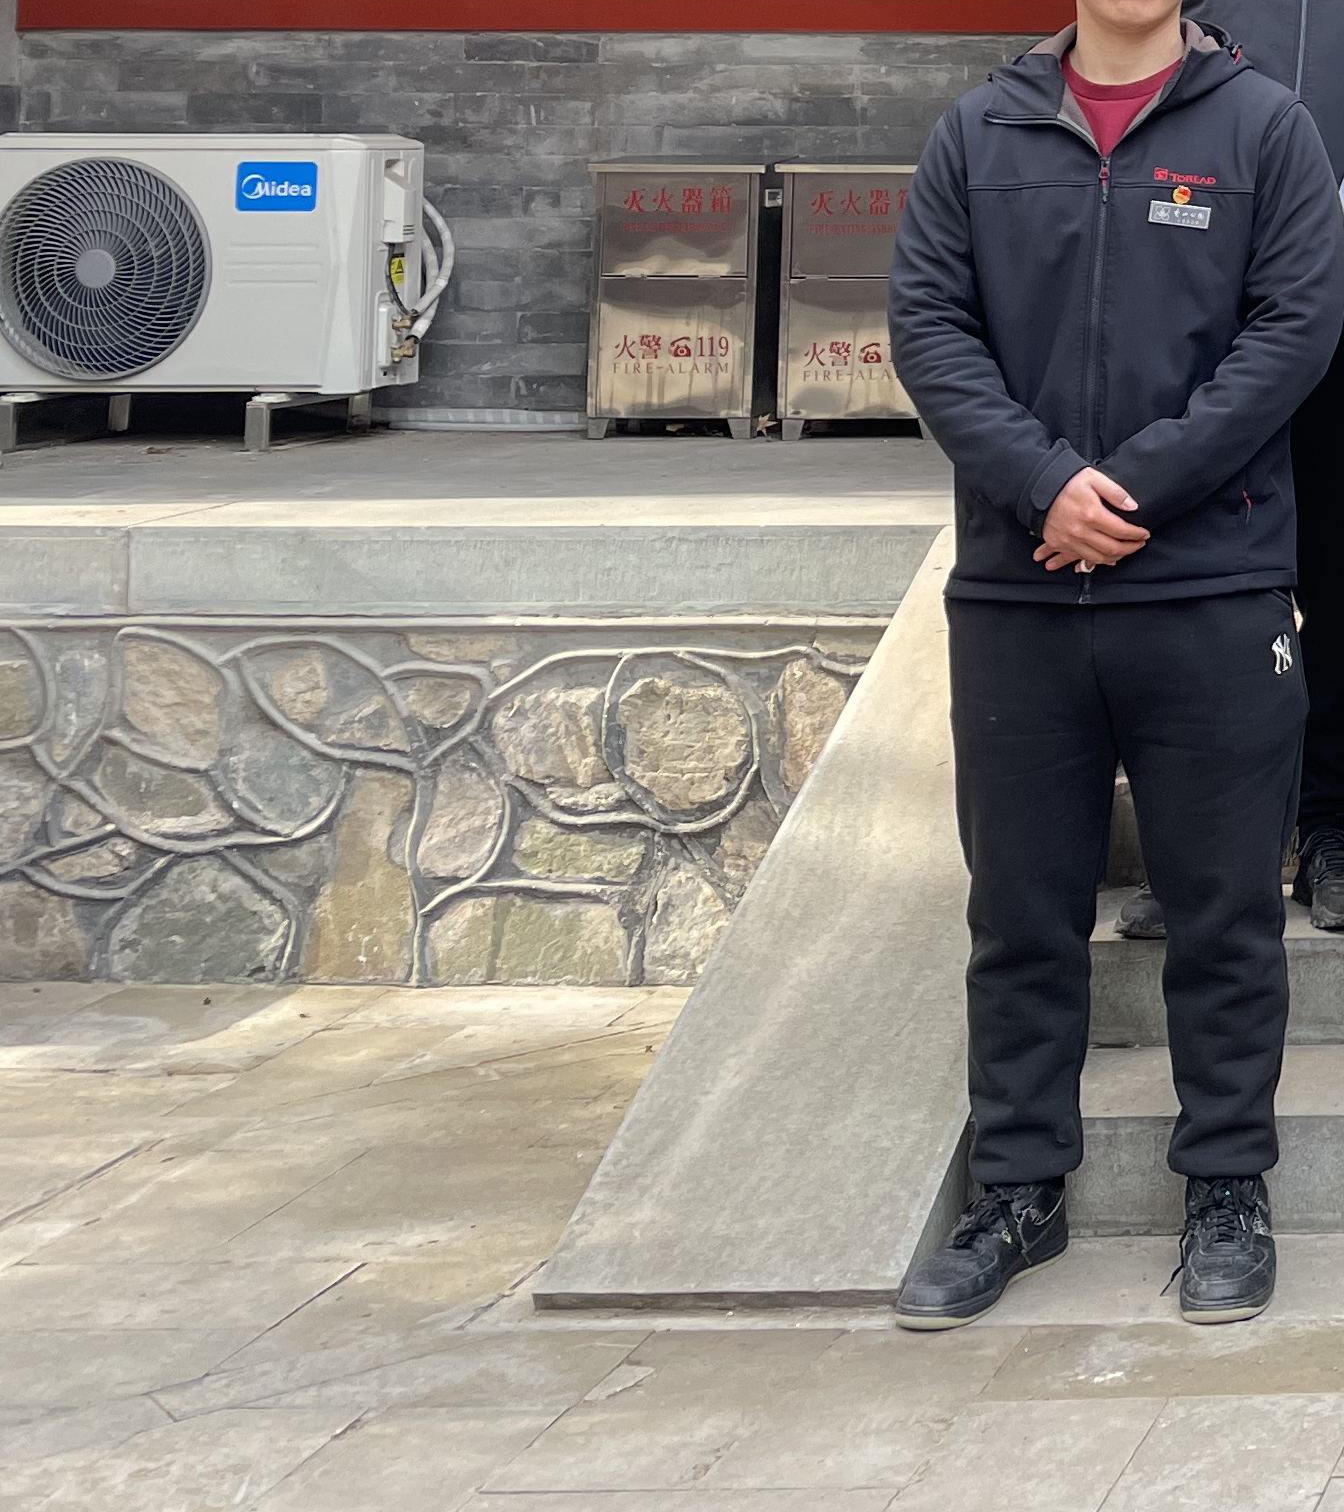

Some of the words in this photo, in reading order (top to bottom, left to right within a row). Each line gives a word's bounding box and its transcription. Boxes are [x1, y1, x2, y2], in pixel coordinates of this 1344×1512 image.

[246, 178, 312, 197] Midea
[624, 186, 732, 215] 灭火器箱
[615, 334, 662, 360] 火警
[697, 336, 729, 358] 119
[804, 341, 852, 367] 火警
[613, 362, 730, 375] FIRE-ALARM
[803, 368, 897, 383] FIRE-ALA
